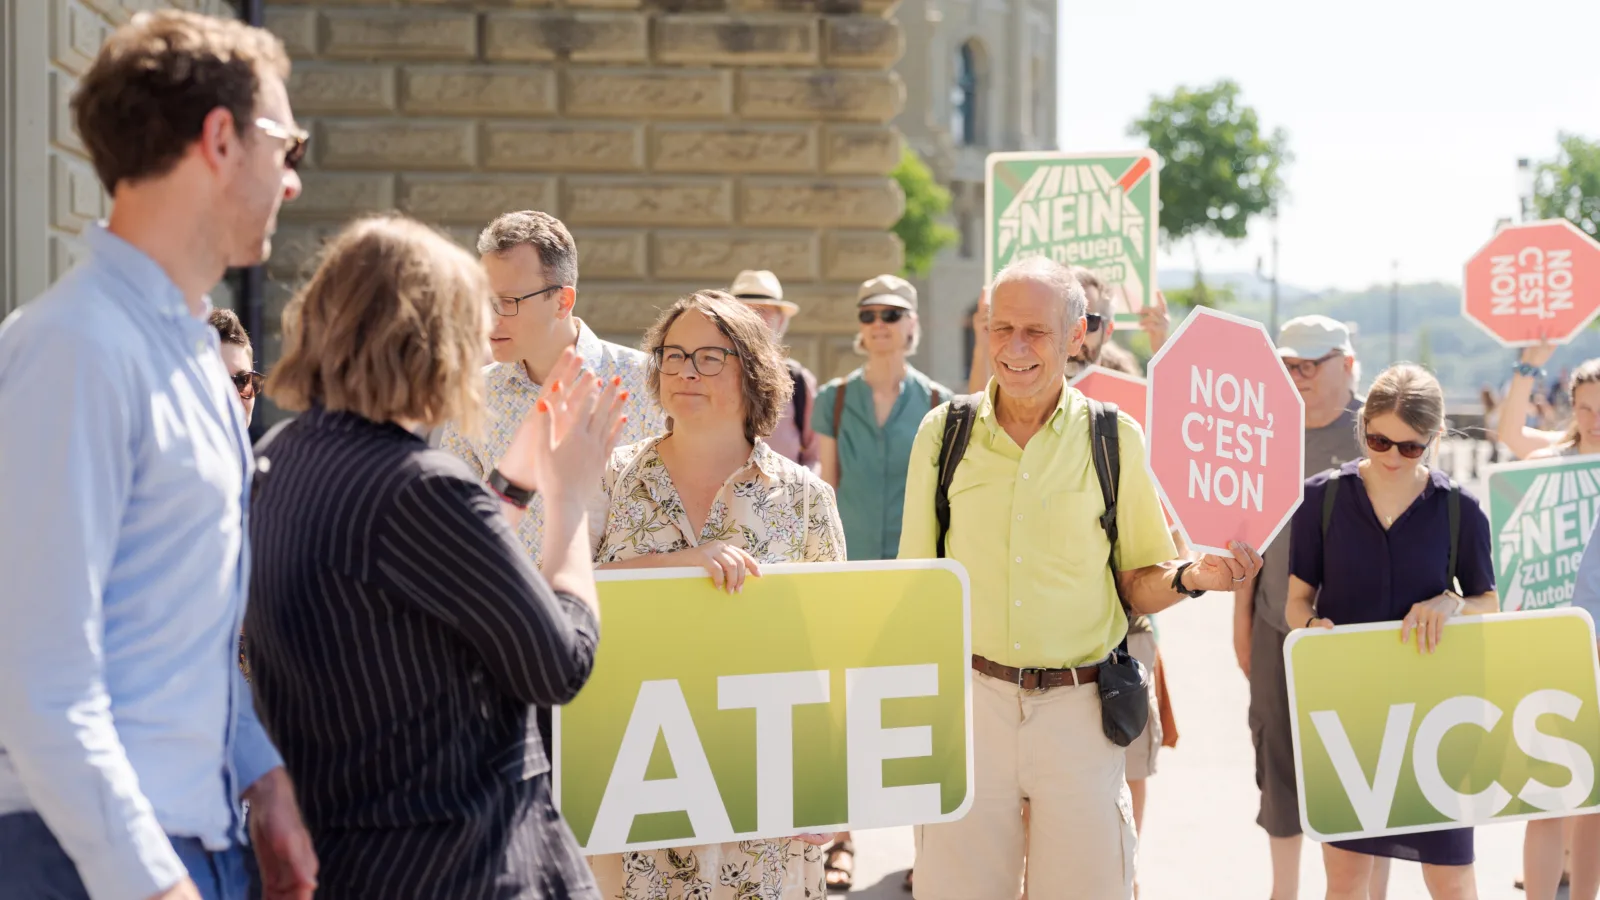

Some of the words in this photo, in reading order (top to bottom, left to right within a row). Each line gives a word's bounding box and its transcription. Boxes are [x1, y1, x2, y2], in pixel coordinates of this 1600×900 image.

[1021, 186, 1122, 246] NEIN
[1052, 237, 1123, 263] neuen
[1490, 254, 1516, 316] NON
[1545, 249, 1574, 318] NON,
[1190, 365, 1274, 430] NON,
[1181, 412, 1274, 466] C'EST
[1188, 459, 1263, 512] NON
[1522, 497, 1600, 560] NEI
[1522, 560, 1550, 586] zu
[1523, 579, 1575, 609] Autob
[587, 663, 942, 848] ATE
[1309, 689, 1594, 832] VCS
